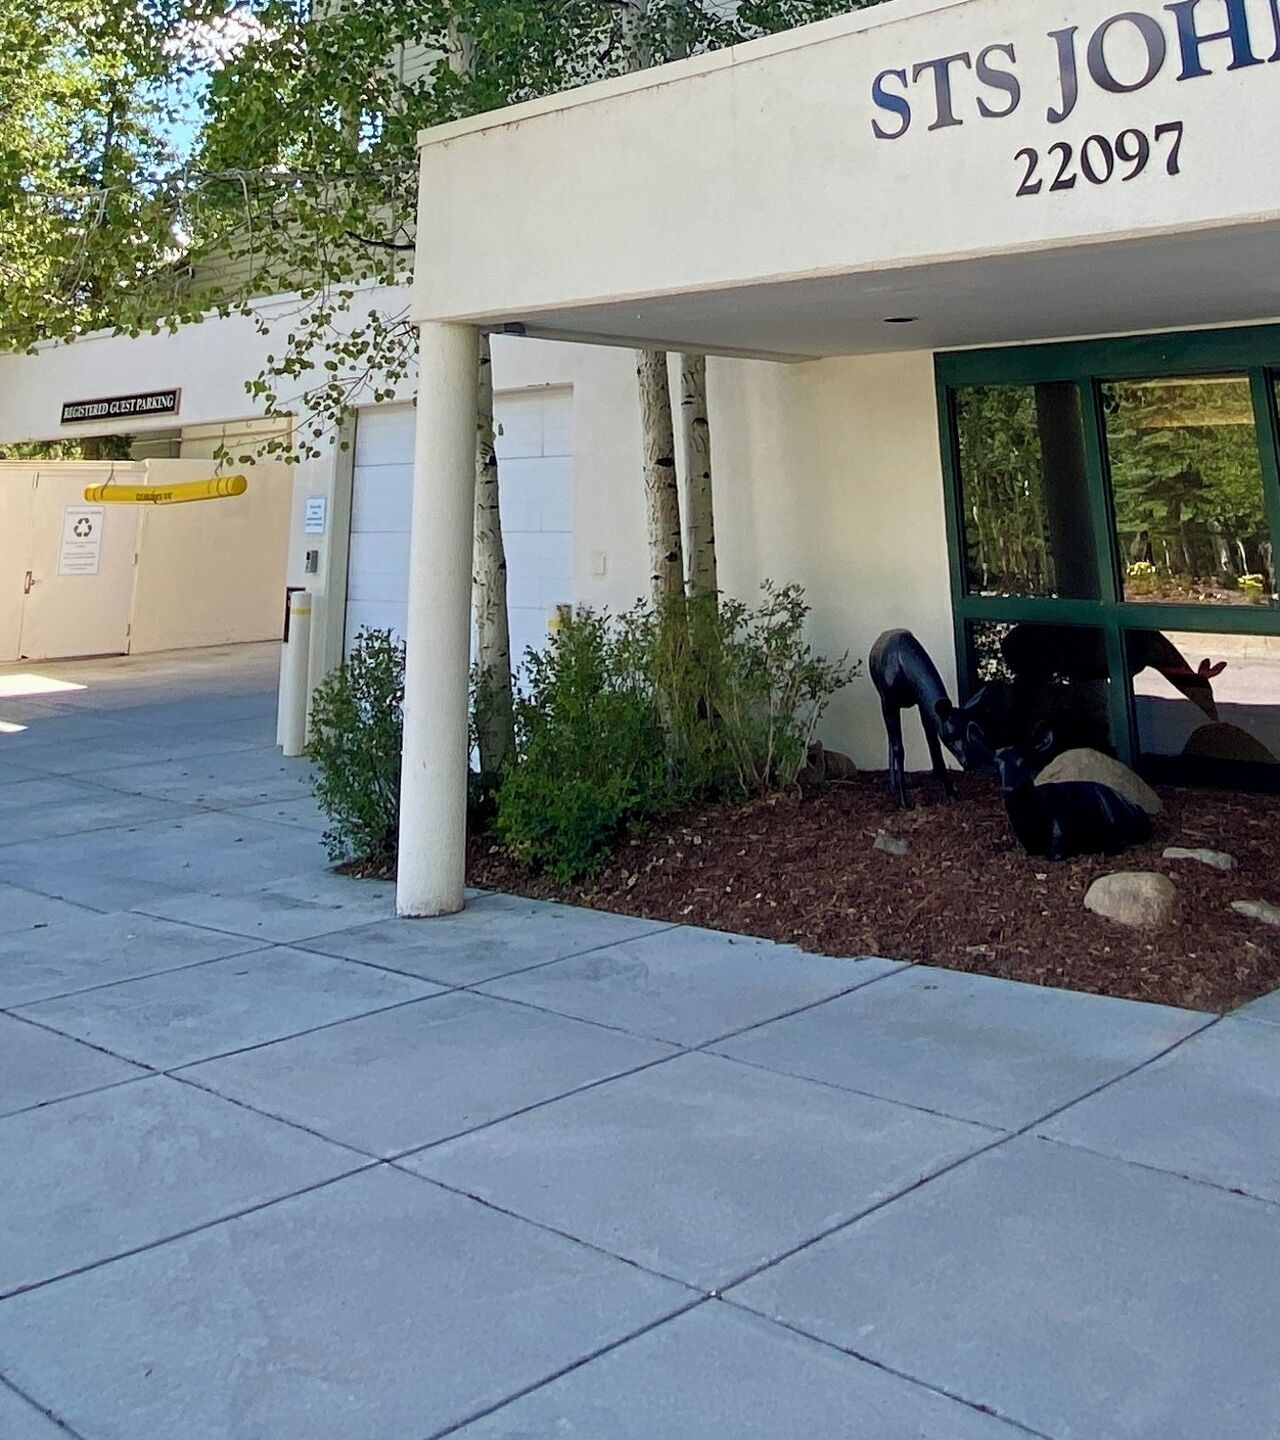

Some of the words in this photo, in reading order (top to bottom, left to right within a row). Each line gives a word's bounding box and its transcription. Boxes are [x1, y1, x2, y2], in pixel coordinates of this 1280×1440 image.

[870, 43, 1021, 140] STS
[1014, 120, 1184, 197] 22097
[63, 402, 109, 419] REGISTERED
[109, 398, 136, 414] GUEST
[136, 394, 174, 411] PARKING
